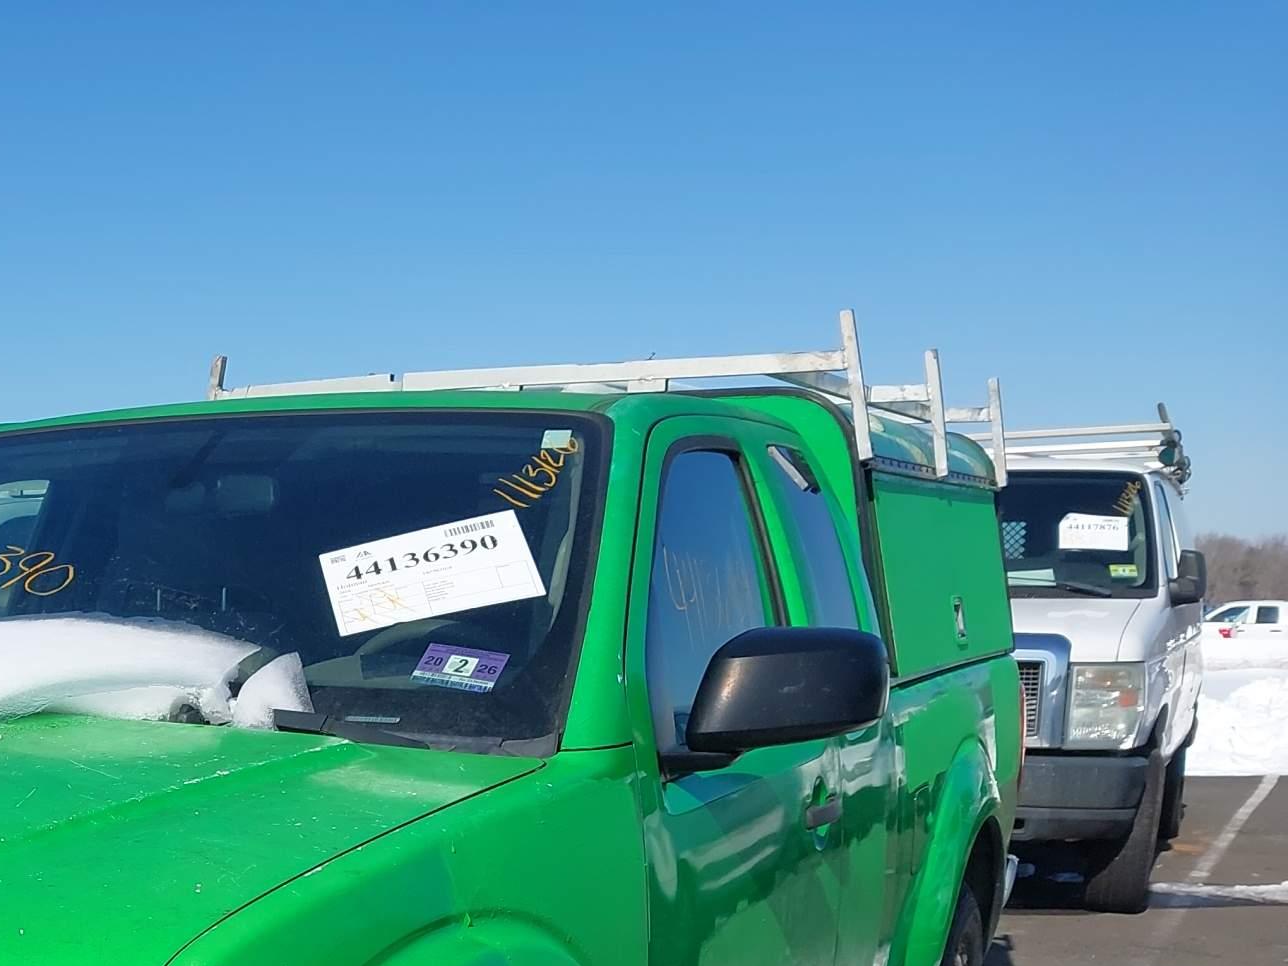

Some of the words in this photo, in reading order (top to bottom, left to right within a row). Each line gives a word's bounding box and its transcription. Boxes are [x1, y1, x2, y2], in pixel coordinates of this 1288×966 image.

[346, 534, 498, 580] 44136390
[424, 655, 444, 667] 20
[453, 658, 469, 674] 2
[477, 664, 498, 675] 26
